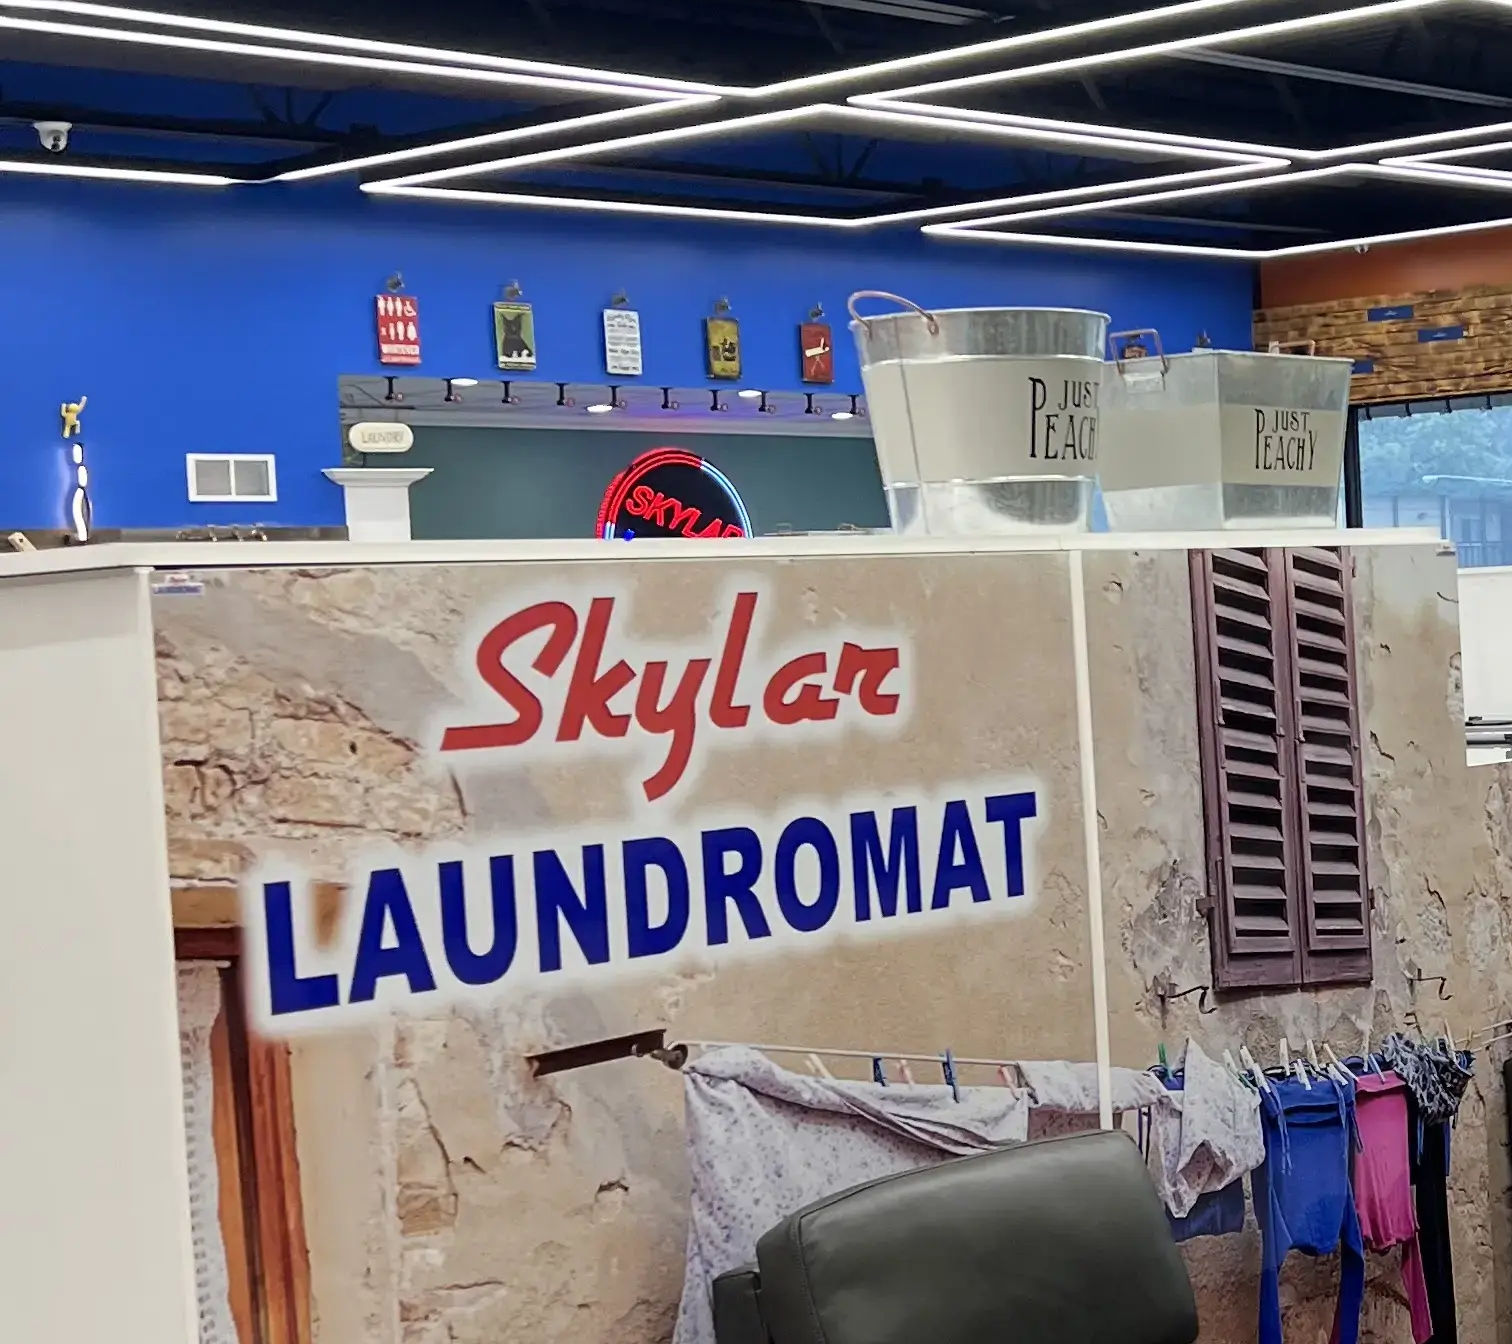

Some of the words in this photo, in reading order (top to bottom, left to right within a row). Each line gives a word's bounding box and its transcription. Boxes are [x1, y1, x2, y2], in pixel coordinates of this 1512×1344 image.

[1028, 377, 1098, 460] PEACH
[1058, 379, 1100, 410] JUST
[1272, 409, 1310, 433] JUST
[1254, 408, 1318, 471] PEACHY
[440, 591, 900, 802] Skylar
[262, 790, 1038, 1016] LAUNDROMAT
